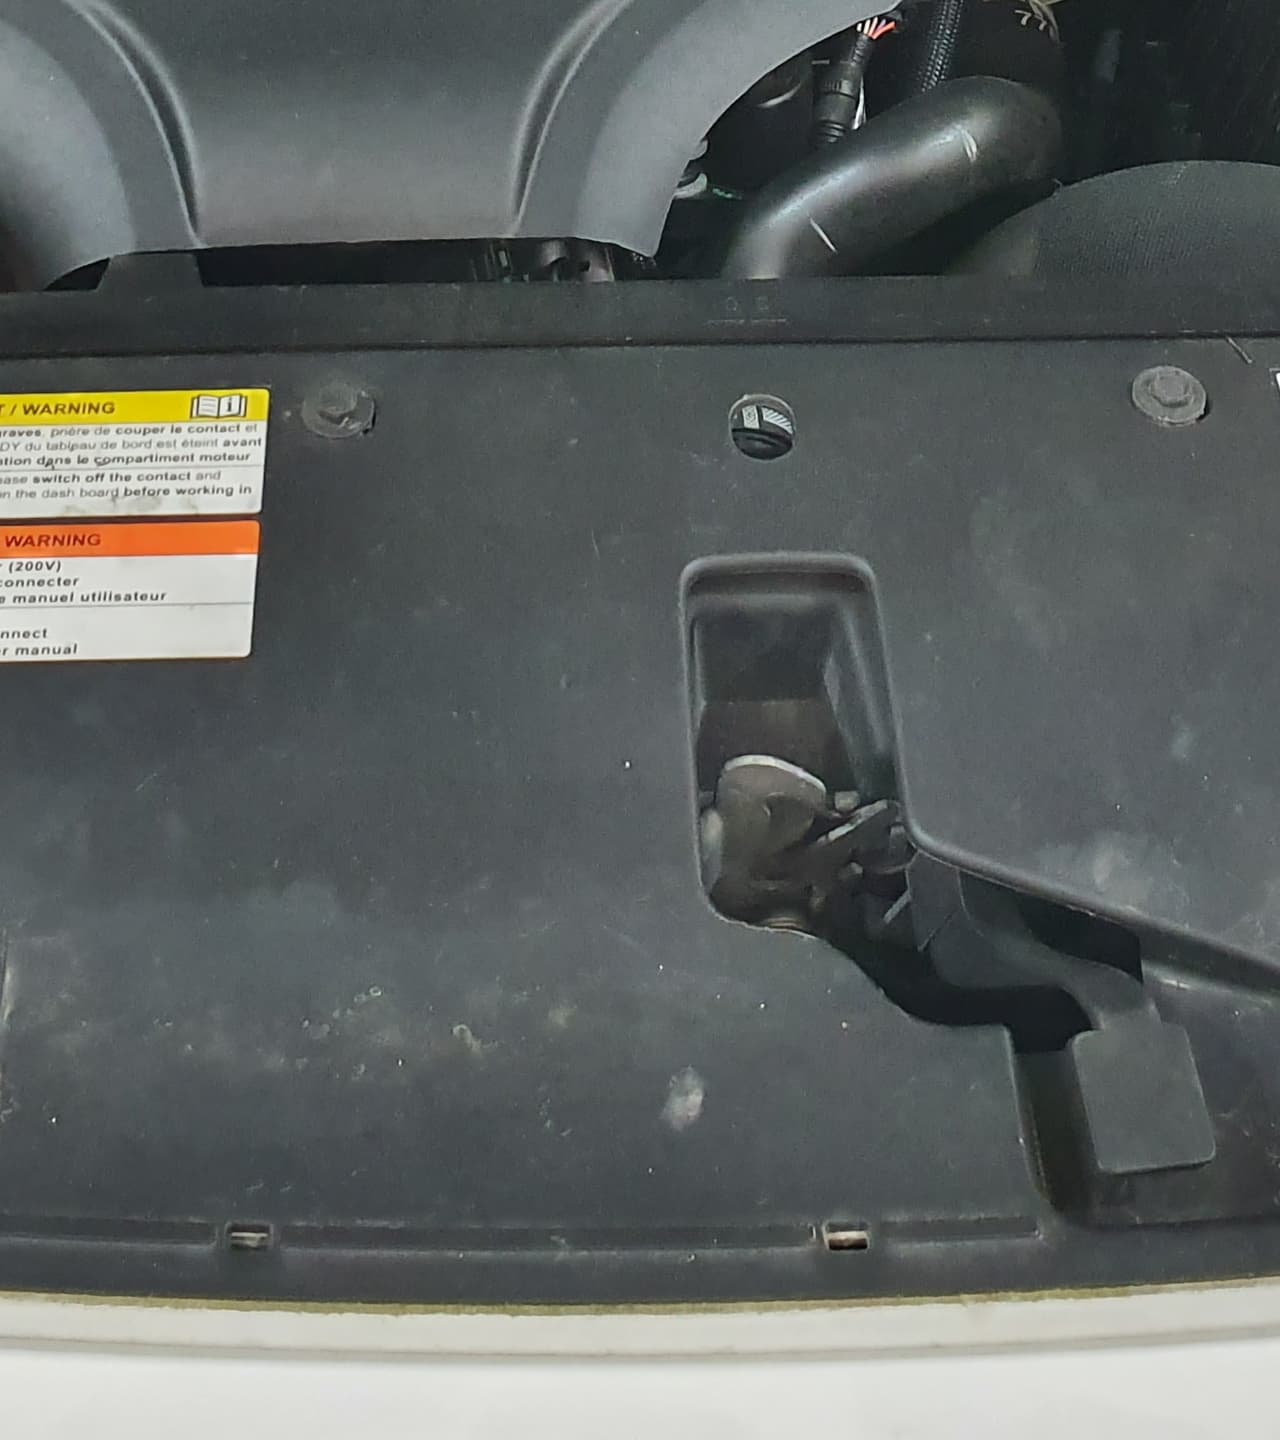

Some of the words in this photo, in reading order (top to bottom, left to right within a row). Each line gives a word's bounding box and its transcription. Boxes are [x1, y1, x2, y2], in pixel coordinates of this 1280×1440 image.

[23, 401, 116, 415] WARNING
[94, 426, 110, 436] de
[115, 426, 165, 437] couper
[170, 425, 182, 435] le
[187, 424, 240, 434] contact
[25, 441, 42, 451] du
[100, 440, 117, 450] de
[122, 439, 152, 449] bord
[156, 439, 177, 449] est
[223, 437, 262, 447] avant
[37, 455, 72, 466] dans
[77, 454, 89, 464] le
[94, 453, 195, 465] compartiment
[199, 452, 251, 462] moteur
[33, 474, 81, 484] switch
[85, 473, 106, 483] off
[109, 472, 132, 482] the
[136, 472, 191, 482] contact
[195, 471, 221, 481] and
[15, 489, 37, 499] the
[41, 488, 75, 499] dash
[80, 487, 120, 498] board
[124, 487, 170, 497] before
[175, 485, 234, 497] working
[239, 485, 252, 495] in
[4, 533, 102, 548] WARNING
[8, 560, 62, 573] (200V)
[12, 591, 75, 604] manuel
[80, 590, 167, 603] utilisateur
[15, 643, 78, 656] manual
